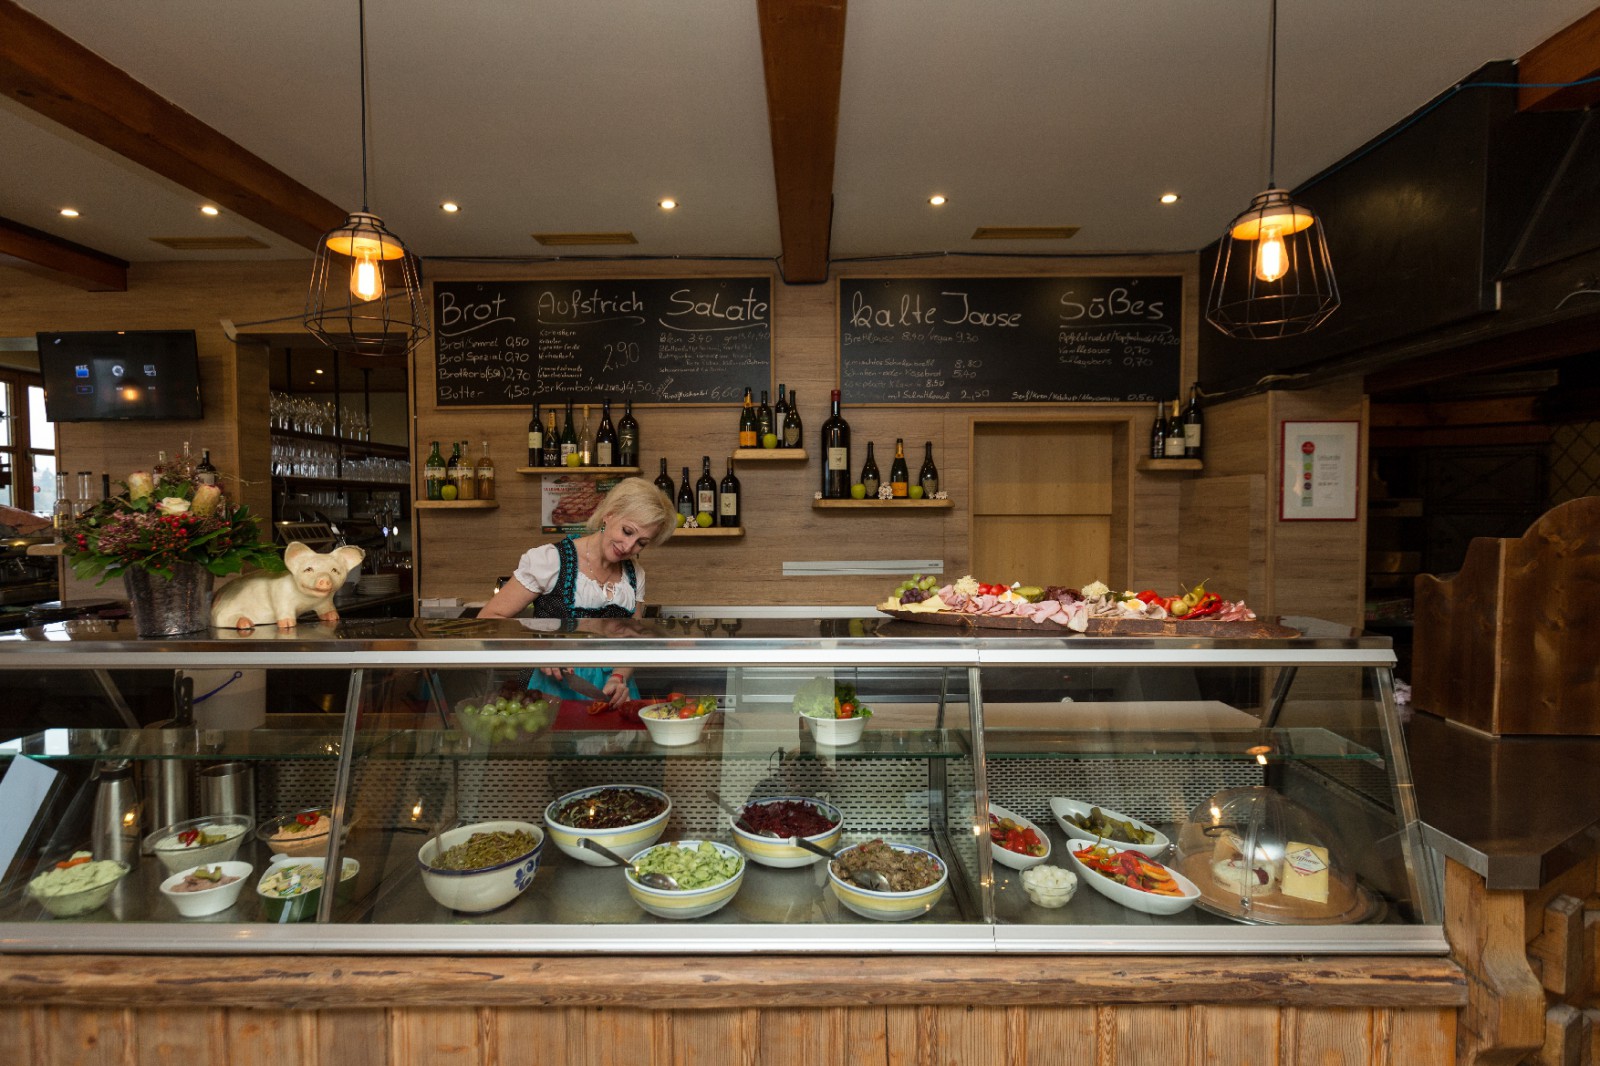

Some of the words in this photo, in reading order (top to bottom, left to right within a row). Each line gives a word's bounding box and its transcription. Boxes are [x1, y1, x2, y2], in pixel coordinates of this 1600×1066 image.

[439, 292, 506, 326] Brot
[538, 288, 644, 318] Aufstrich
[666, 287, 769, 321] Salate
[941, 291, 1022, 328] Jause
[602, 341, 640, 373] 2,90
